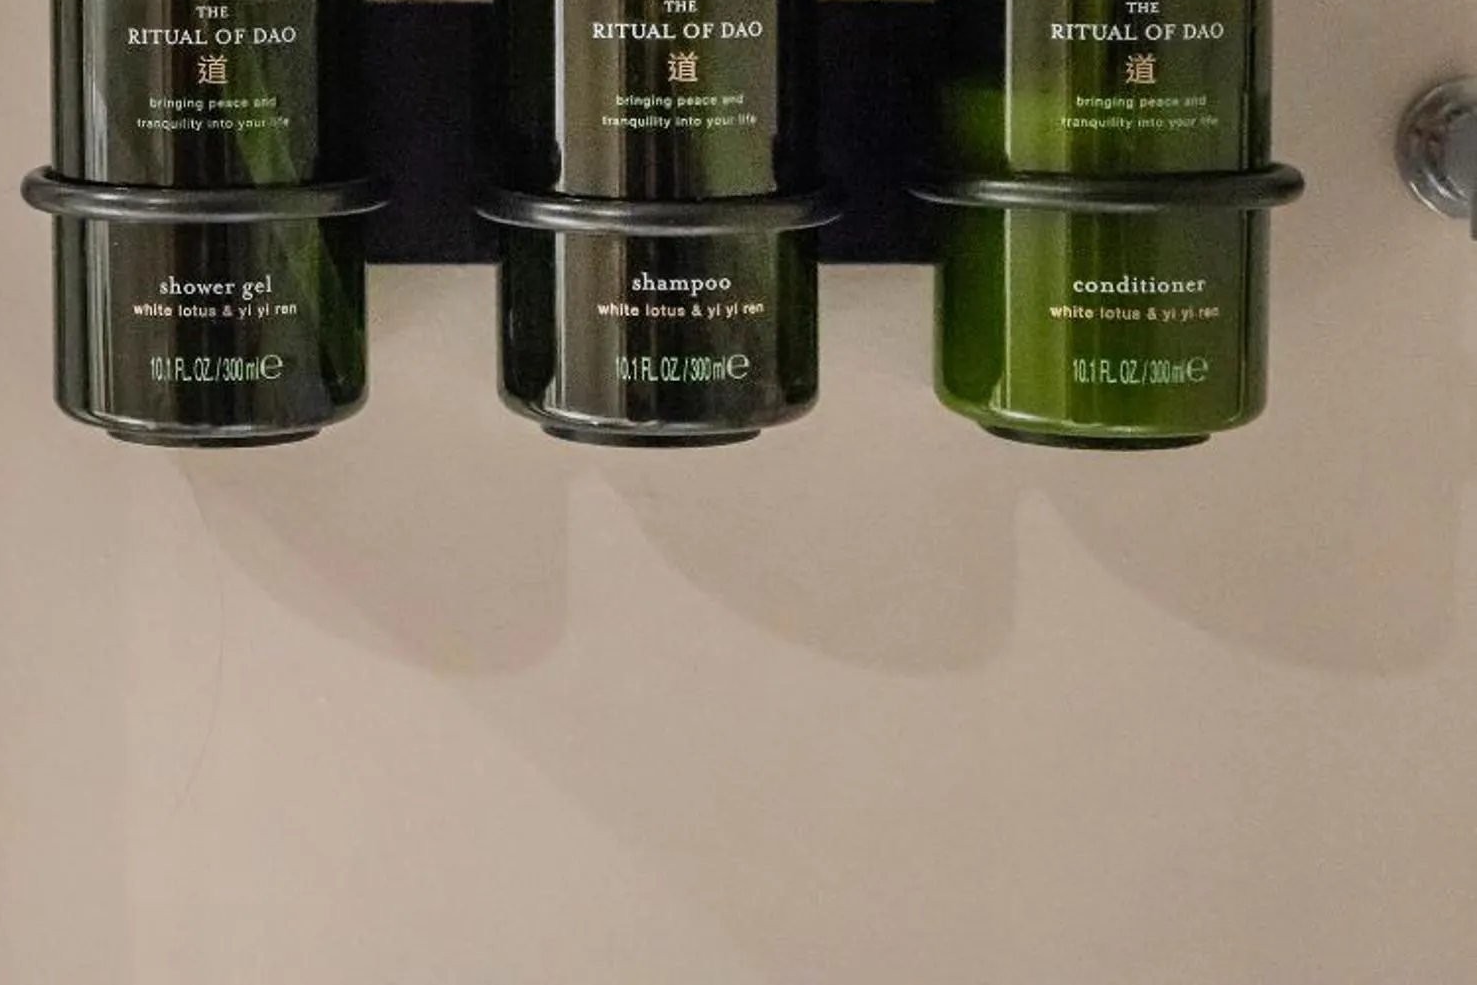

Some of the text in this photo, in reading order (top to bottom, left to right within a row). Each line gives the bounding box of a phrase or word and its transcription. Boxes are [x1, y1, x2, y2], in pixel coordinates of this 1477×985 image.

[196, 6, 229, 19] THE
[664, 0, 698, 13] THE
[1125, 1, 1160, 14] THE
[128, 27, 296, 45] RITUAL OF DAO
[592, 21, 762, 39] RITUAL OF DAO
[1051, 22, 1224, 41] RITUAL OF DAO
[197, 54, 228, 85] 道
[667, 52, 699, 83] 道
[1125, 53, 1157, 84] 道
[149, 96, 276, 110] bringing peace and
[616, 95, 673, 109] bringing
[677, 96, 717, 108] peace
[1076, 95, 1207, 110] bringing peace and
[137, 118, 202, 131] tranquility
[207, 118, 233, 128] into
[602, 116, 671, 129] tranquility
[676, 116, 702, 127] into
[707, 117, 734, 129] your
[1061, 117, 1133, 129] tranquility
[1138, 118, 1163, 127] into
[159, 274, 273, 300] shower gel
[632, 271, 732, 297] shampoo
[1073, 275, 1206, 293] conditioner
[133, 303, 297, 320] white lotus & yi yi ren
[597, 303, 765, 319] white lotus & yi yi ren
[1049, 305, 1094, 319] white
[1100, 306, 1141, 320] lotus
[1147, 307, 1157, 320] &
[150, 356, 171, 381] 10.1
[616, 356, 637, 381] 10.1
[1073, 359, 1096, 383] 10.1
